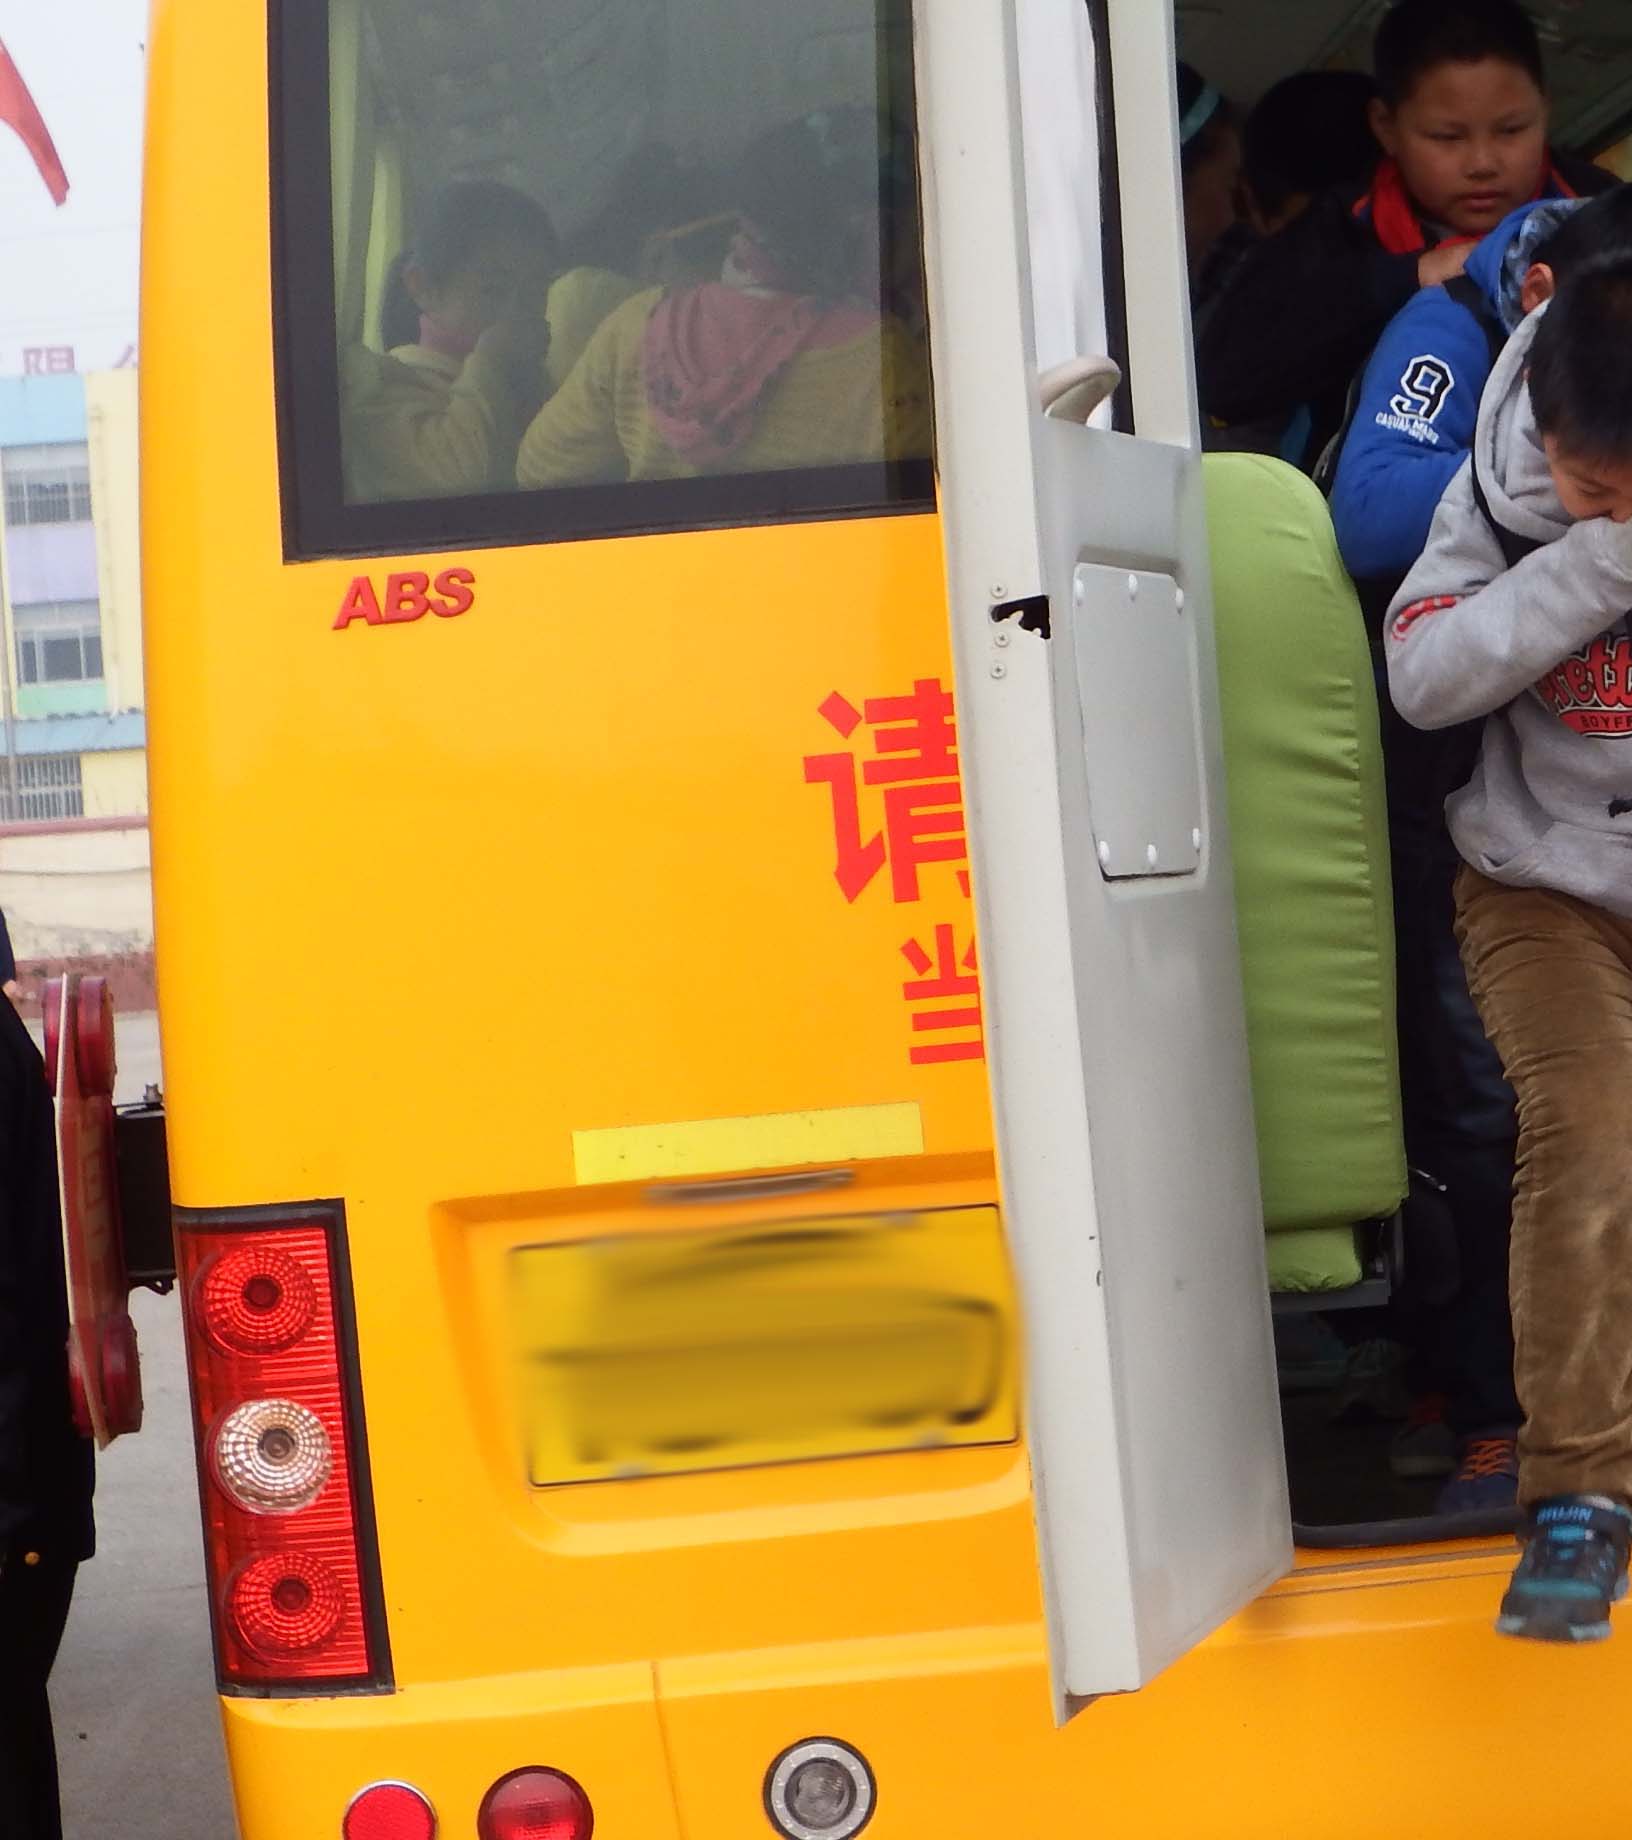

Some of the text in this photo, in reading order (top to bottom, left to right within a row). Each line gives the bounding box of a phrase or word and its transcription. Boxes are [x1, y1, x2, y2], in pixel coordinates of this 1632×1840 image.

[1390, 354, 1455, 424] 9
[332, 567, 475, 630] ABS
[803, 678, 972, 904] 请
[900, 923, 985, 1066] 当
